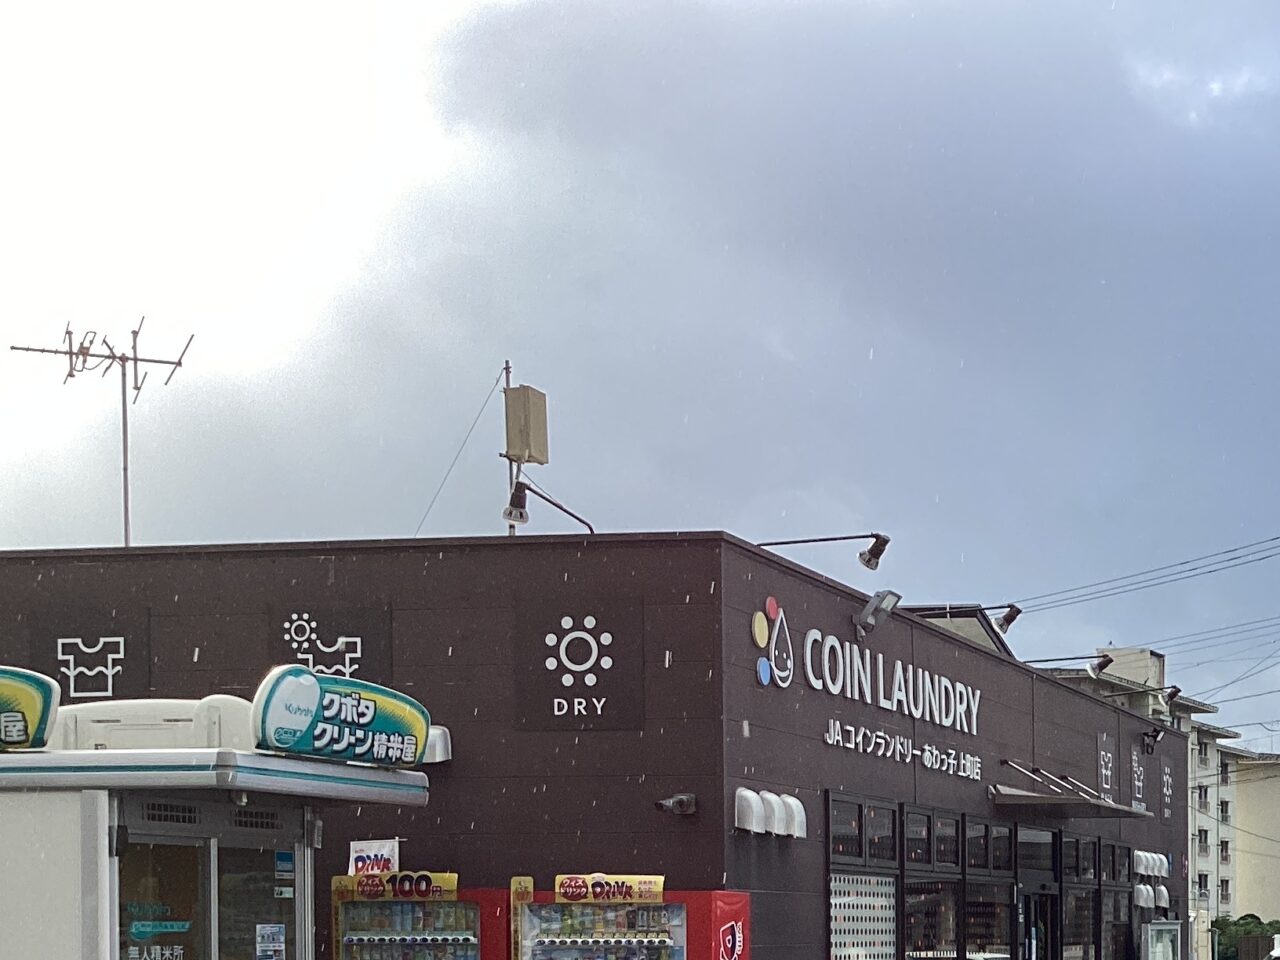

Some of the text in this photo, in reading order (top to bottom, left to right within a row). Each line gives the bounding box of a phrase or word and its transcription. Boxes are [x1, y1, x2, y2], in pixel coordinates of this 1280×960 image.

[803, 629, 981, 736] COIN LAUNDRY
[322, 692, 376, 725] クボタ
[553, 697, 607, 716] DRY
[313, 722, 418, 763] クリーン精米屋
[591, 881, 634, 901] DRINK
